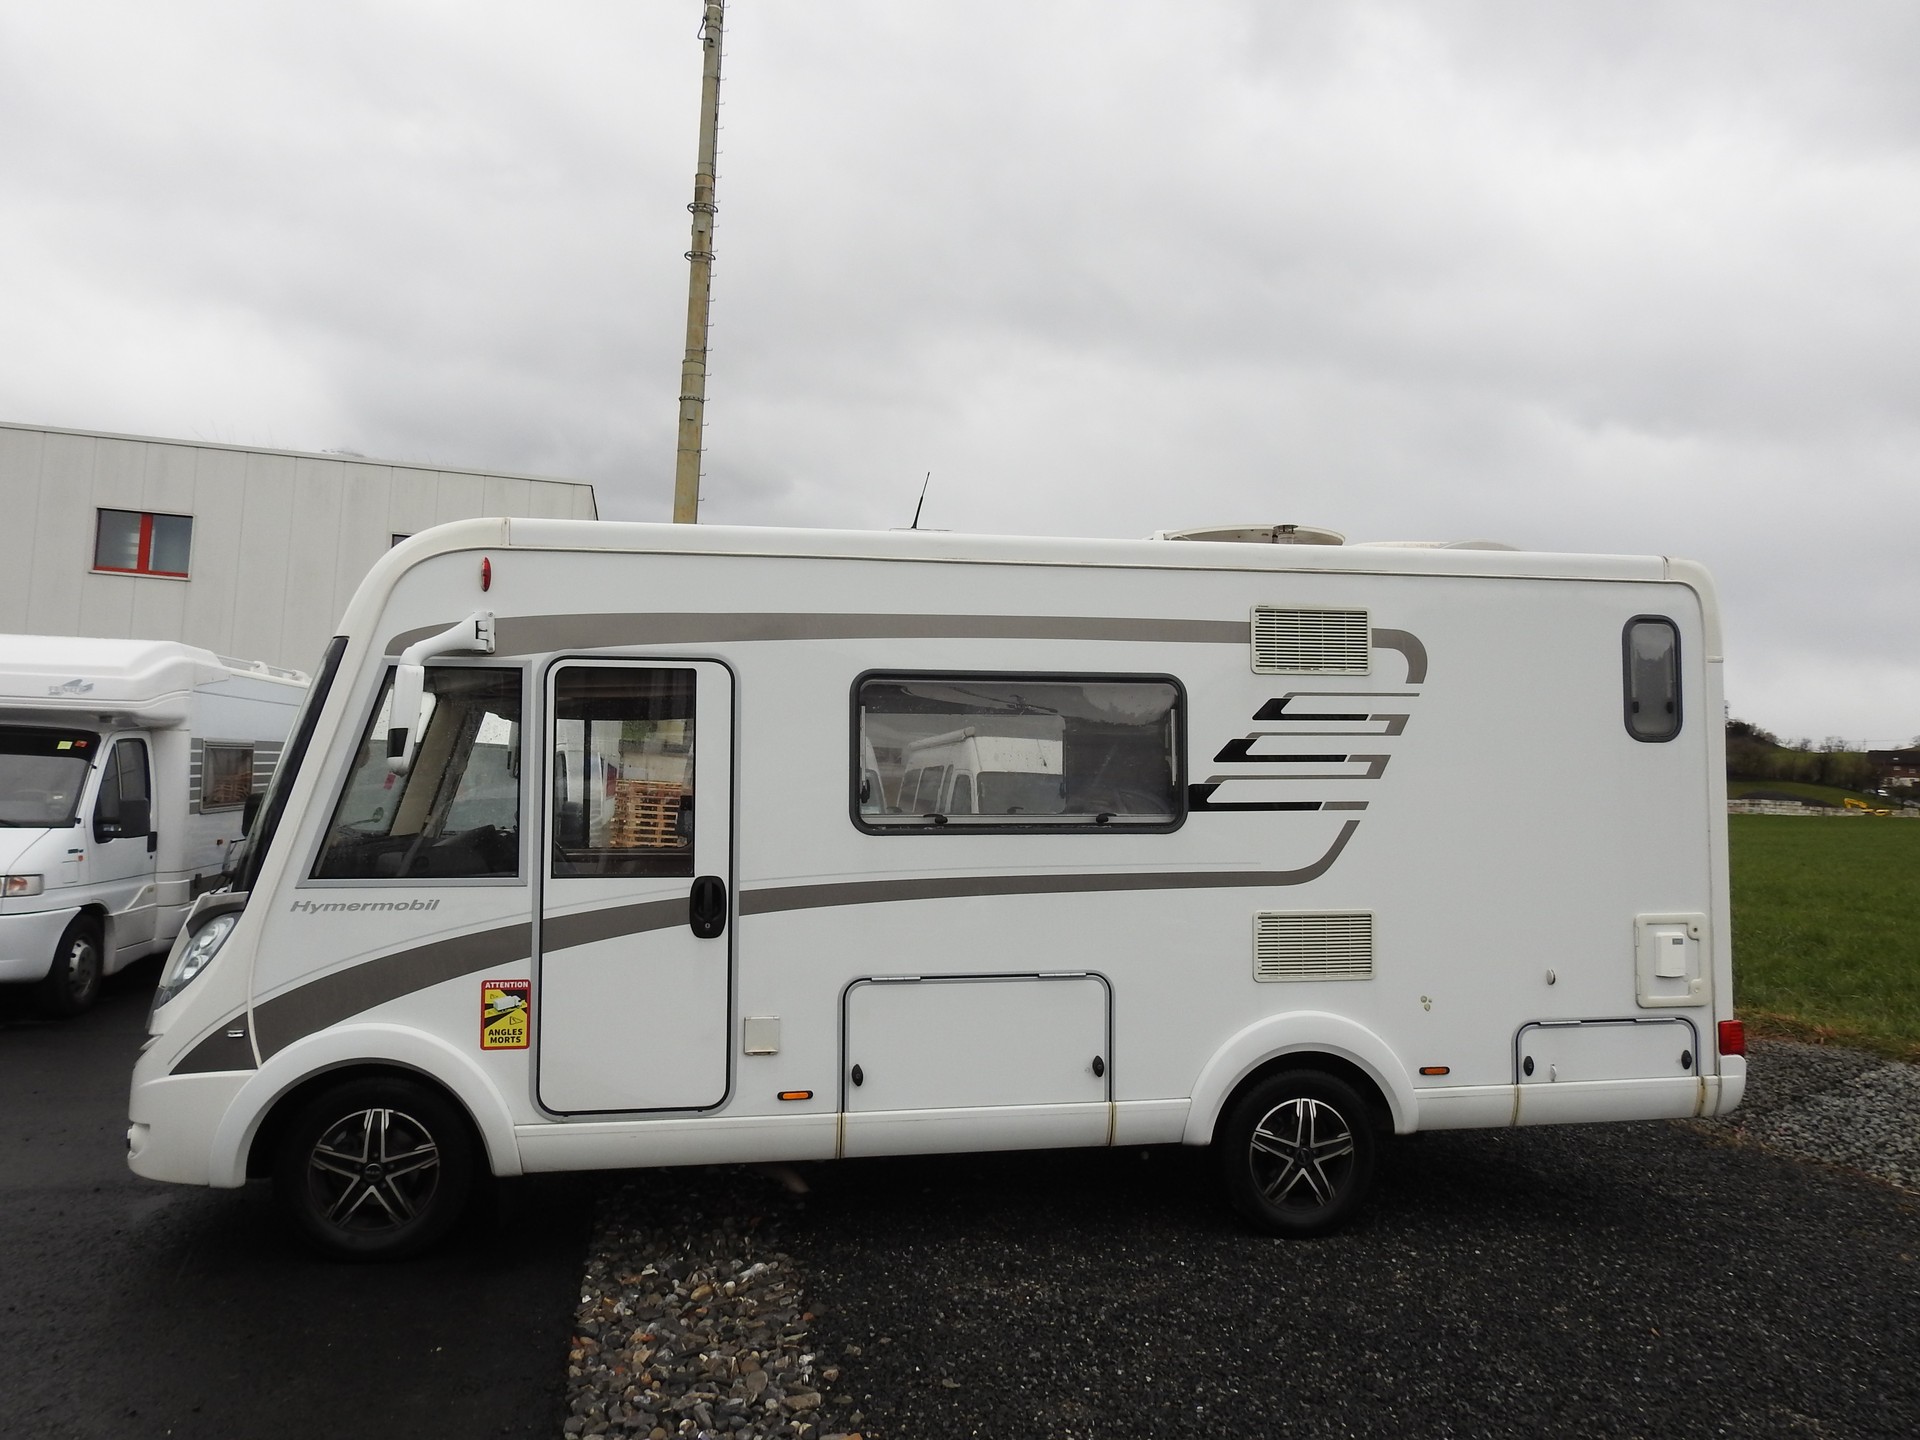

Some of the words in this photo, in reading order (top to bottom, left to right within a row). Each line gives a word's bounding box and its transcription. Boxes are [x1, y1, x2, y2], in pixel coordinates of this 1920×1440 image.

[290, 899, 440, 914] Hymermobil
[485, 981, 529, 989] ATTENTION
[488, 1028, 523, 1036] ANGLES
[490, 1036, 521, 1044] MORTS
